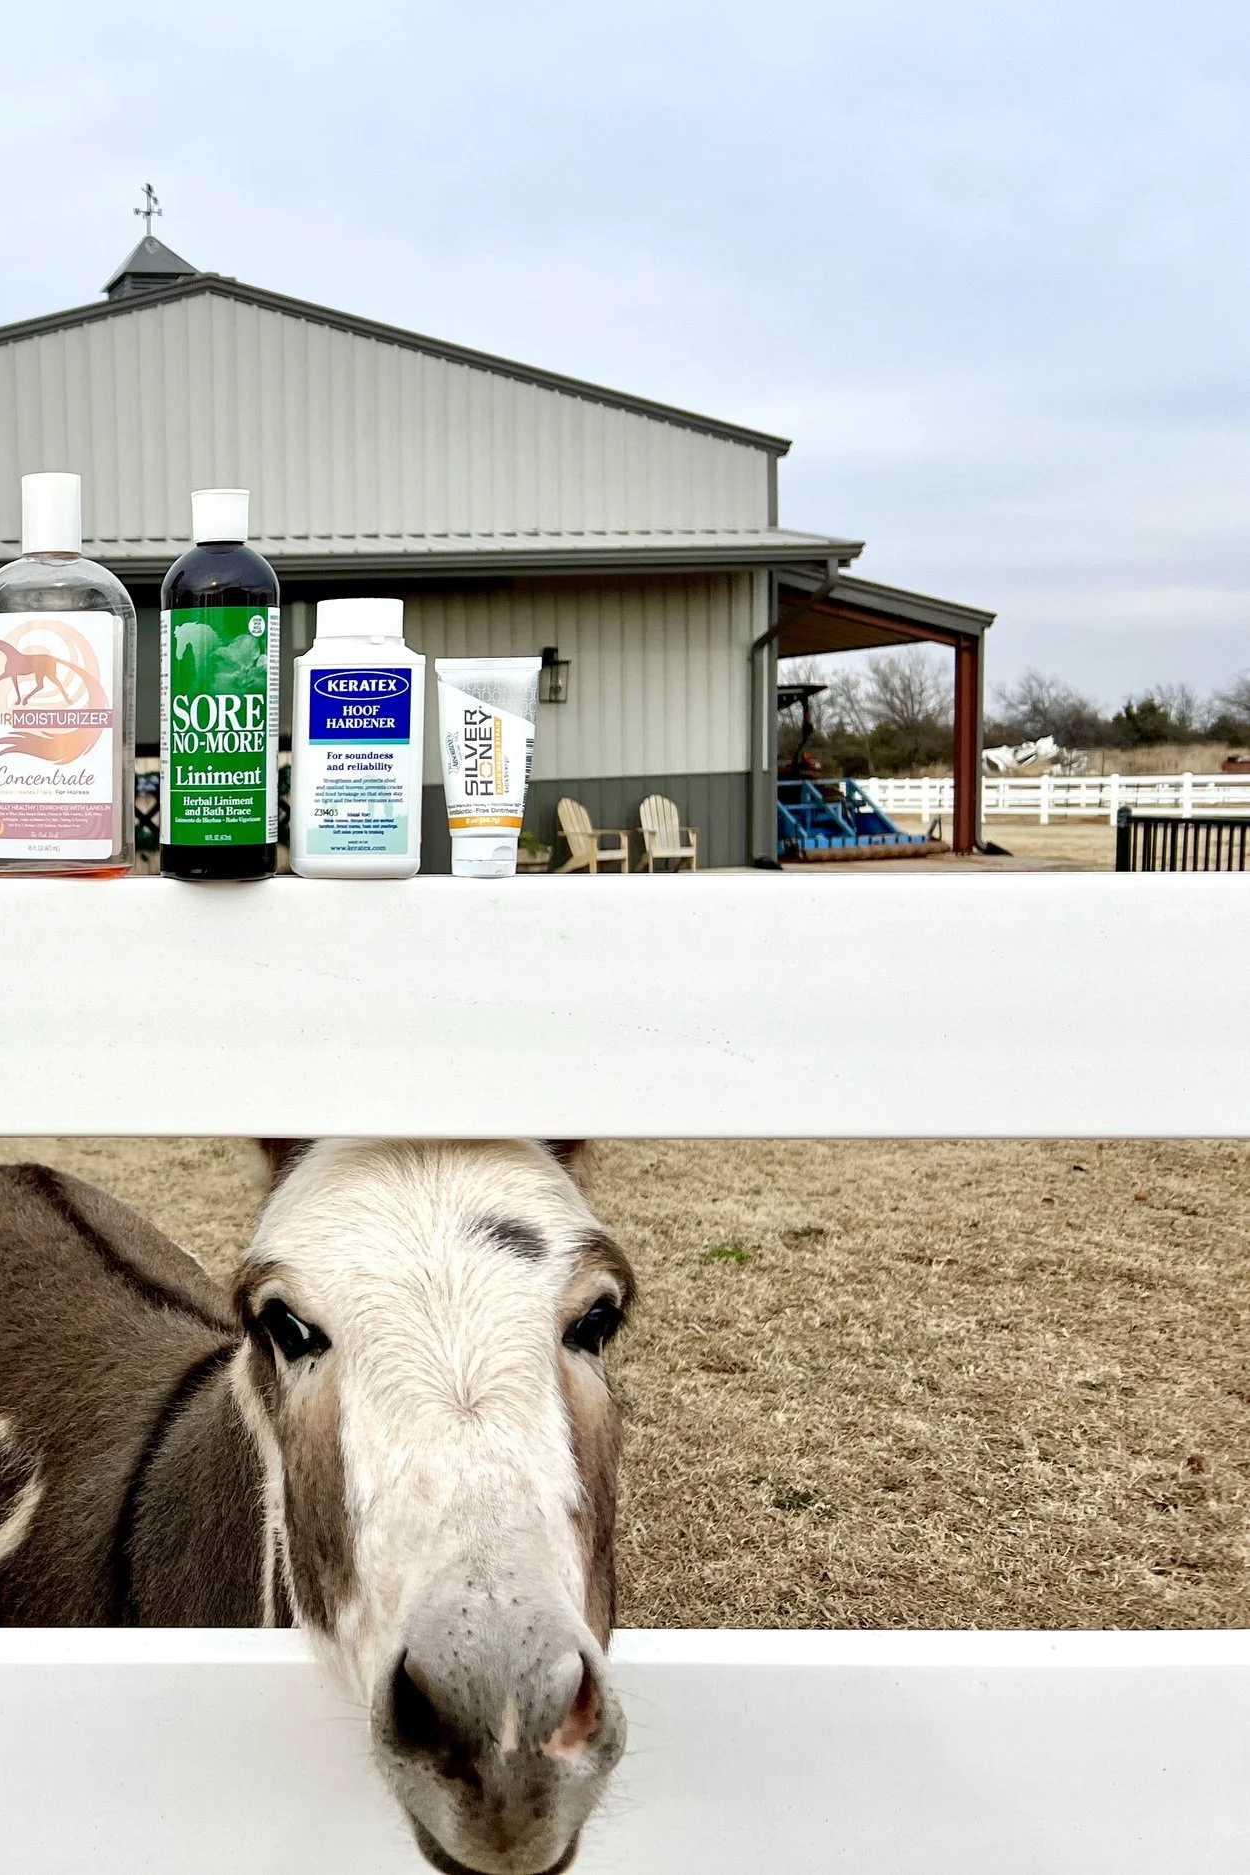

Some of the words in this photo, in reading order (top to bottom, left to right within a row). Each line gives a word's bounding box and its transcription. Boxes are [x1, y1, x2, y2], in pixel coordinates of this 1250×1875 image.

[327, 679, 397, 692] KERATEX
[172, 694, 265, 733] SORE
[343, 705, 380, 716] HOOF
[326, 718, 395, 729] HARDENER
[172, 732, 266, 754] NO-MORE
[327, 752, 342, 760] For
[345, 752, 394, 760] soundness
[464, 709, 479, 796] SILVER
[327, 763, 344, 771] and
[347, 762, 393, 772] reliability
[175, 765, 262, 786] Liniment
[183, 796, 212, 806] Herbal
[214, 796, 253, 806] Liniment
[185, 807, 201, 816] and
[203, 807, 224, 816] Bath
[226, 806, 251, 815] Brace
